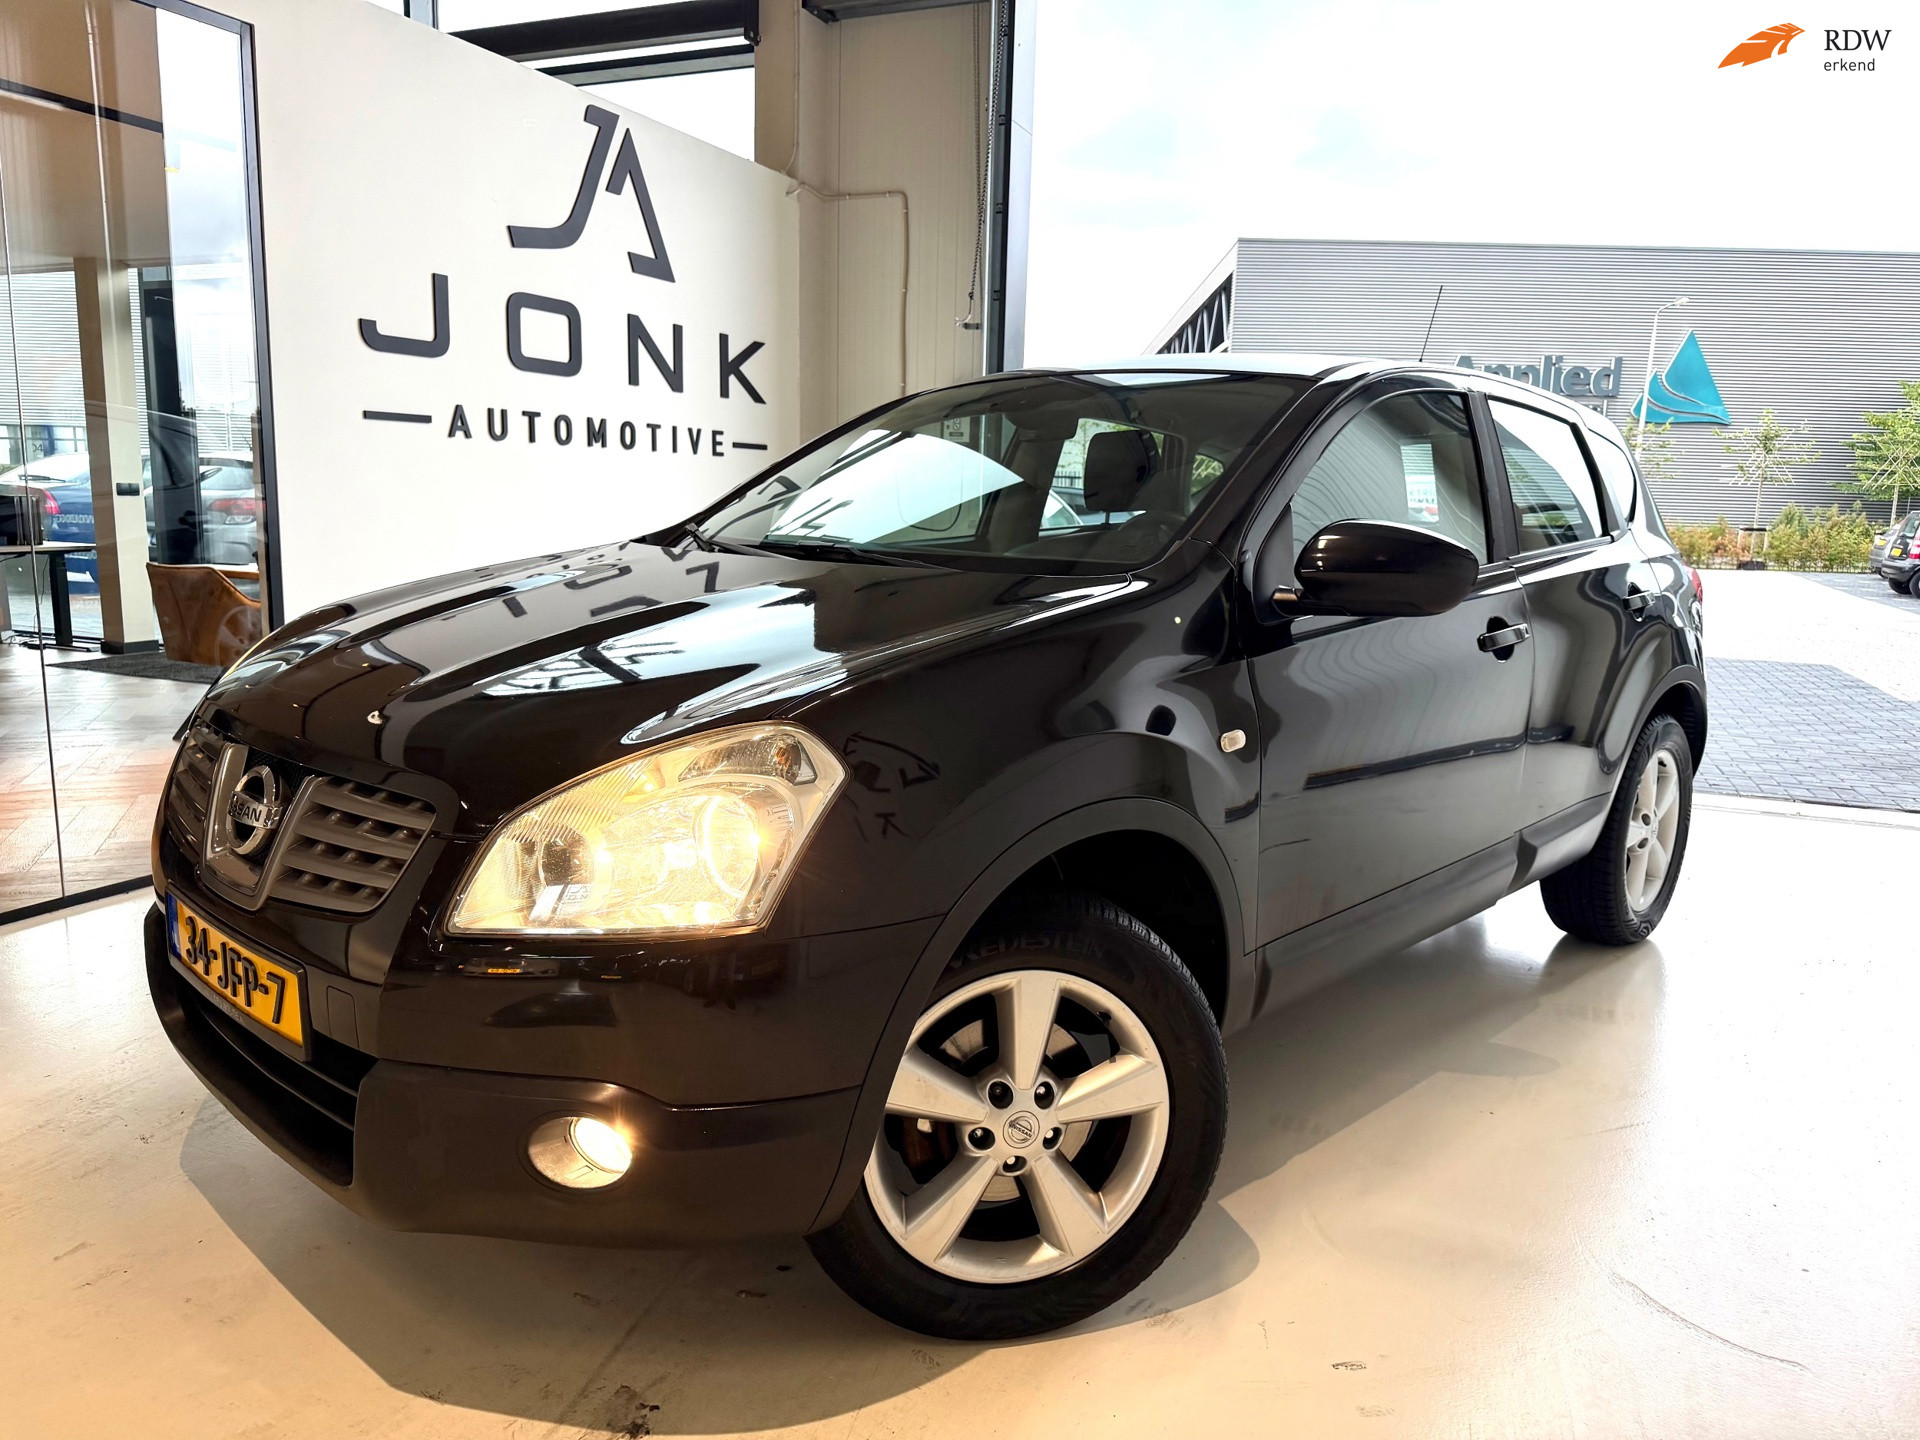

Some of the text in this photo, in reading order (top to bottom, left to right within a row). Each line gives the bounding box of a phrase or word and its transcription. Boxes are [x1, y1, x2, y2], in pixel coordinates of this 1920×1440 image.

[358, 272, 767, 405] JONK
[448, 403, 725, 457] AUTOMOTIVE
[185, 915, 286, 1025] 34-JFP-7
